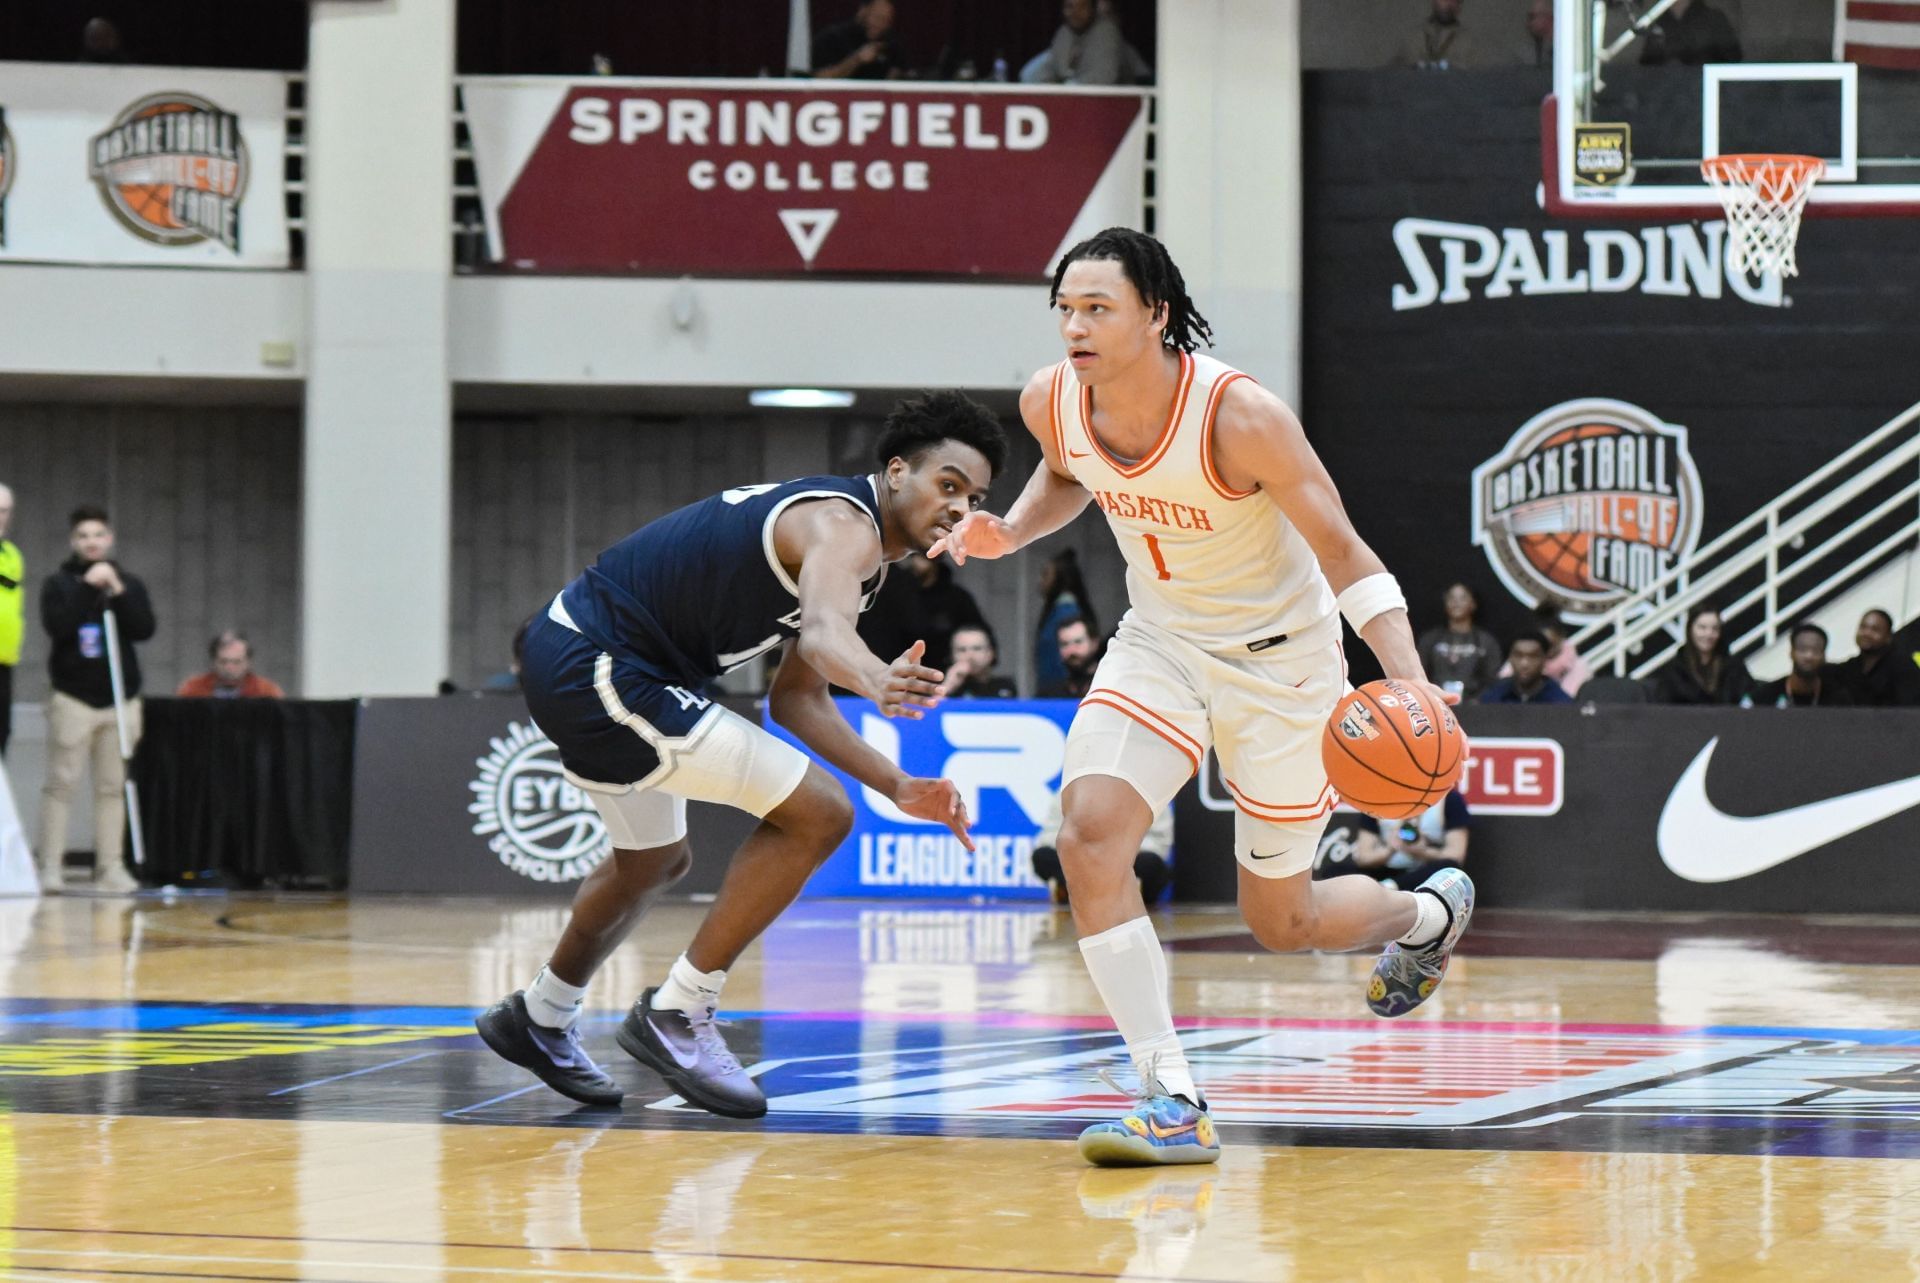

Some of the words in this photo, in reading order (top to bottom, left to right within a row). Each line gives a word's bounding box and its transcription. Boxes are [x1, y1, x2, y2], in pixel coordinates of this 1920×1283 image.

[570, 98, 1049, 150] SPRINGFIELD
[688, 161, 930, 191] COLLEGE
[1392, 217, 1783, 309] SPALDING
[1494, 434, 1672, 511] BASKETBALL
[1563, 496, 1624, 534] HALL
[1637, 498, 1675, 546] OF
[1142, 533, 1171, 580] 1
[1384, 680, 1434, 738] SPALDIN
[1457, 757, 1542, 795] TLE
